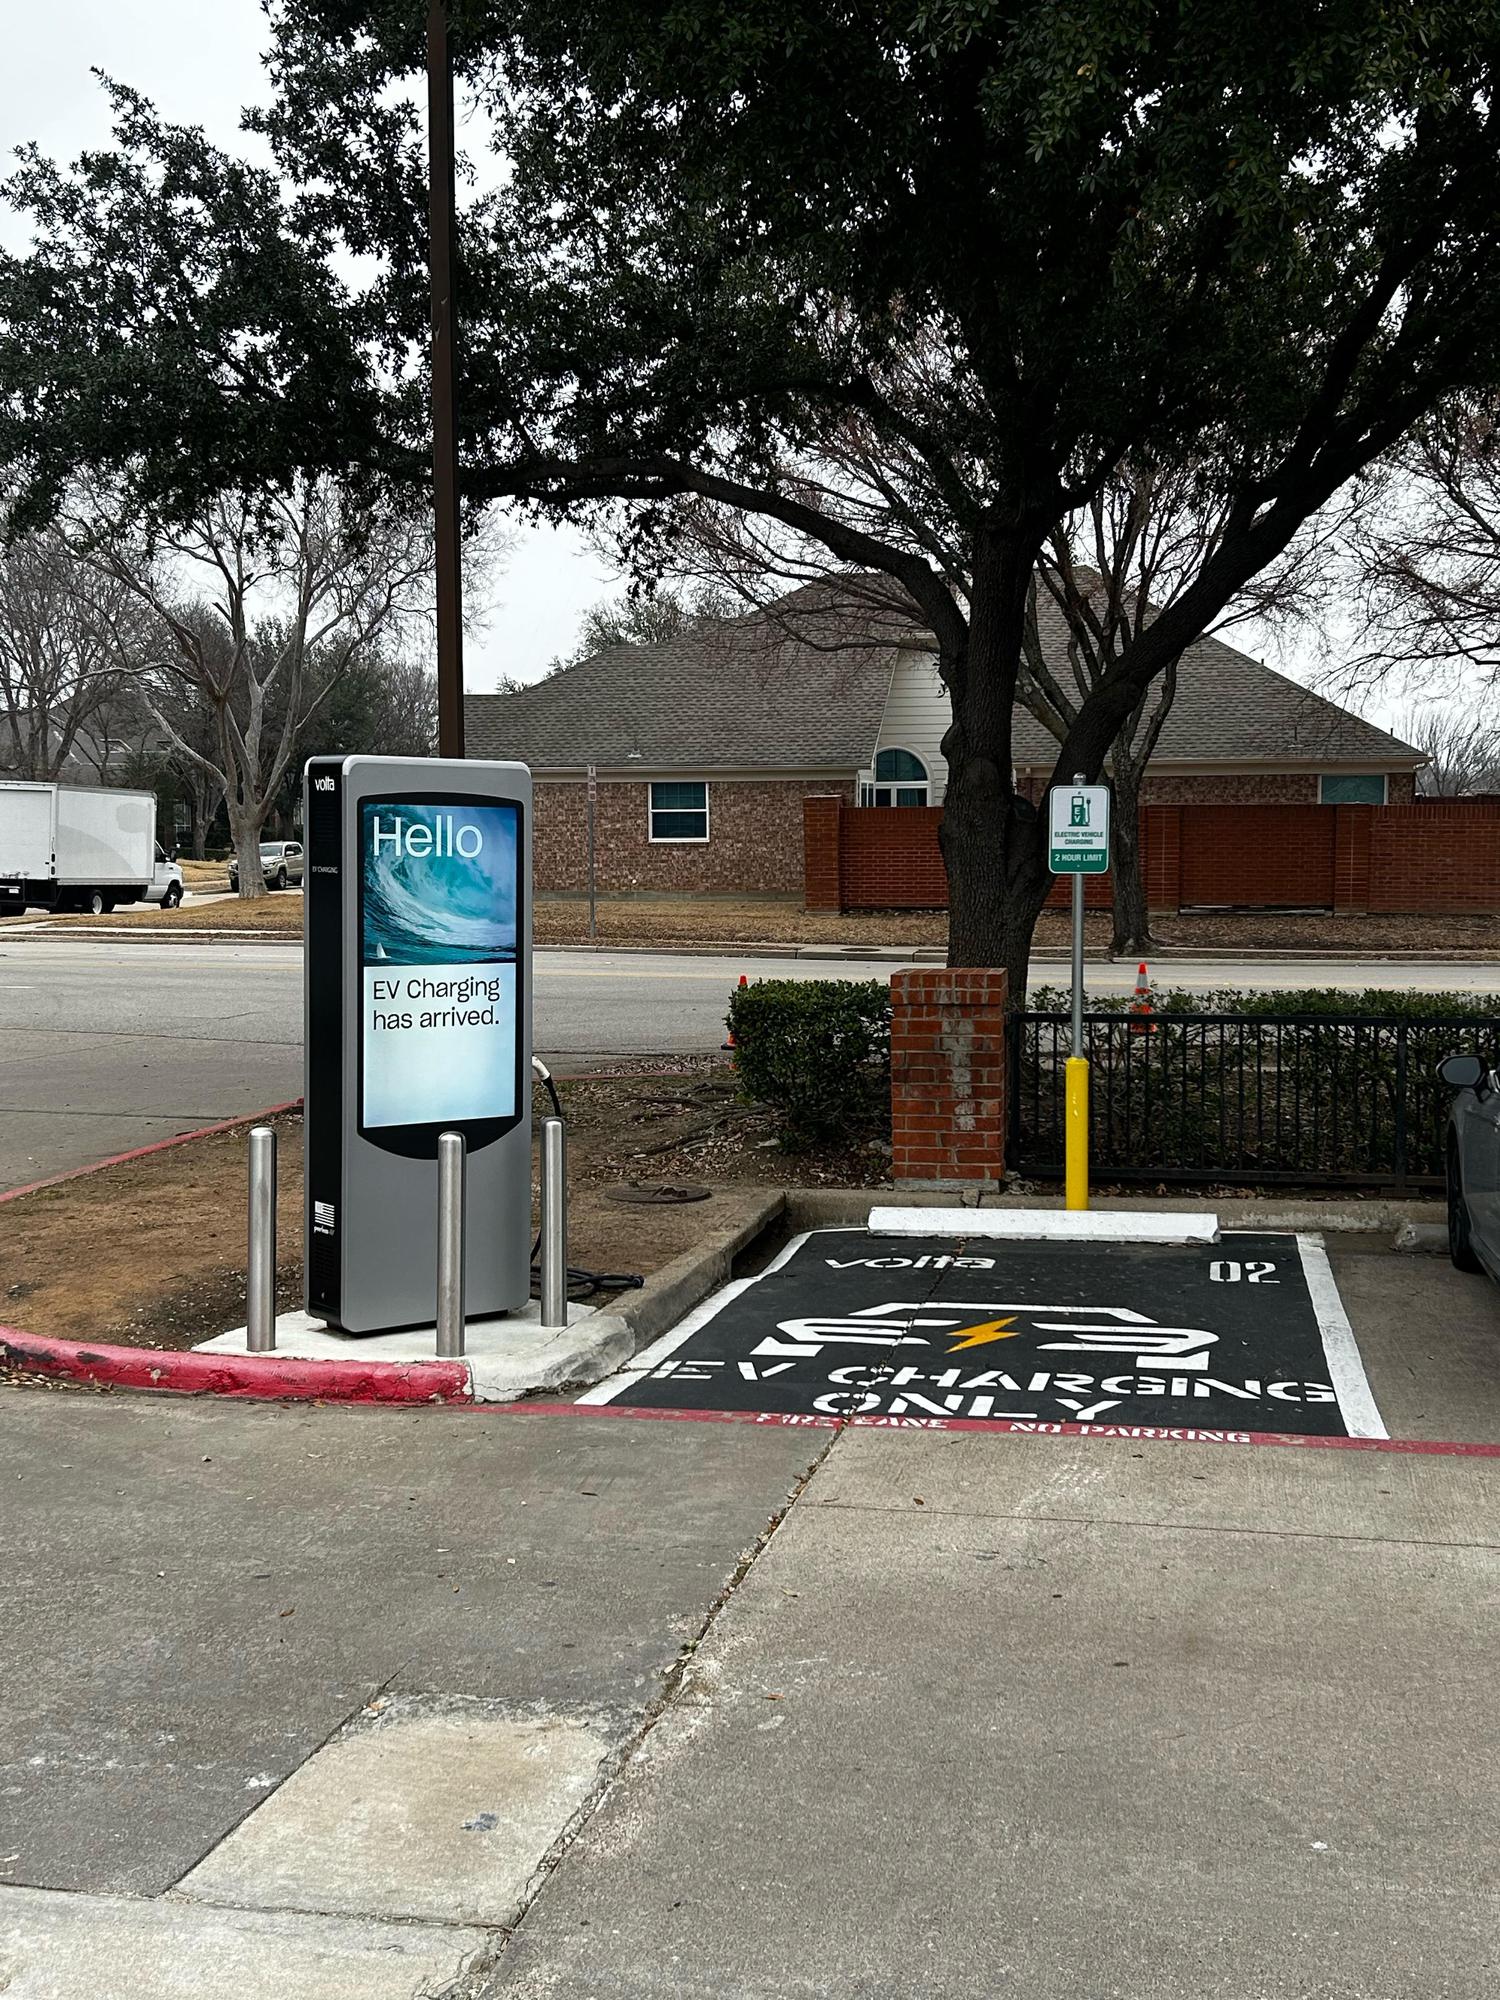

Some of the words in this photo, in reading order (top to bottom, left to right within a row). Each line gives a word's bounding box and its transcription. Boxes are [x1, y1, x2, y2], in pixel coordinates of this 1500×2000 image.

[315, 776, 335, 791] volta
[1074, 807, 1081, 823] EV
[373, 815, 483, 858] Hello
[1054, 854, 1061, 862] 2
[1061, 854, 1082, 862] HOUR
[1082, 854, 1103, 862] LIMIT
[373, 979, 400, 1000] EV
[406, 976, 500, 1003] Charging
[373, 1009, 413, 1031] has
[419, 1005, 500, 1028] arrived.
[824, 1255, 997, 1271] volta
[1208, 1260, 1281, 1284] 02
[650, 1360, 797, 1381] EV
[827, 1365, 1337, 1403] CHARGING
[812, 1392, 1123, 1421] ONLY
[755, 1412, 840, 1427] FIRE
[853, 1415, 950, 1429] LANE
[1009, 1422, 1061, 1434] NO
[1080, 1424, 1251, 1444] PARKING
